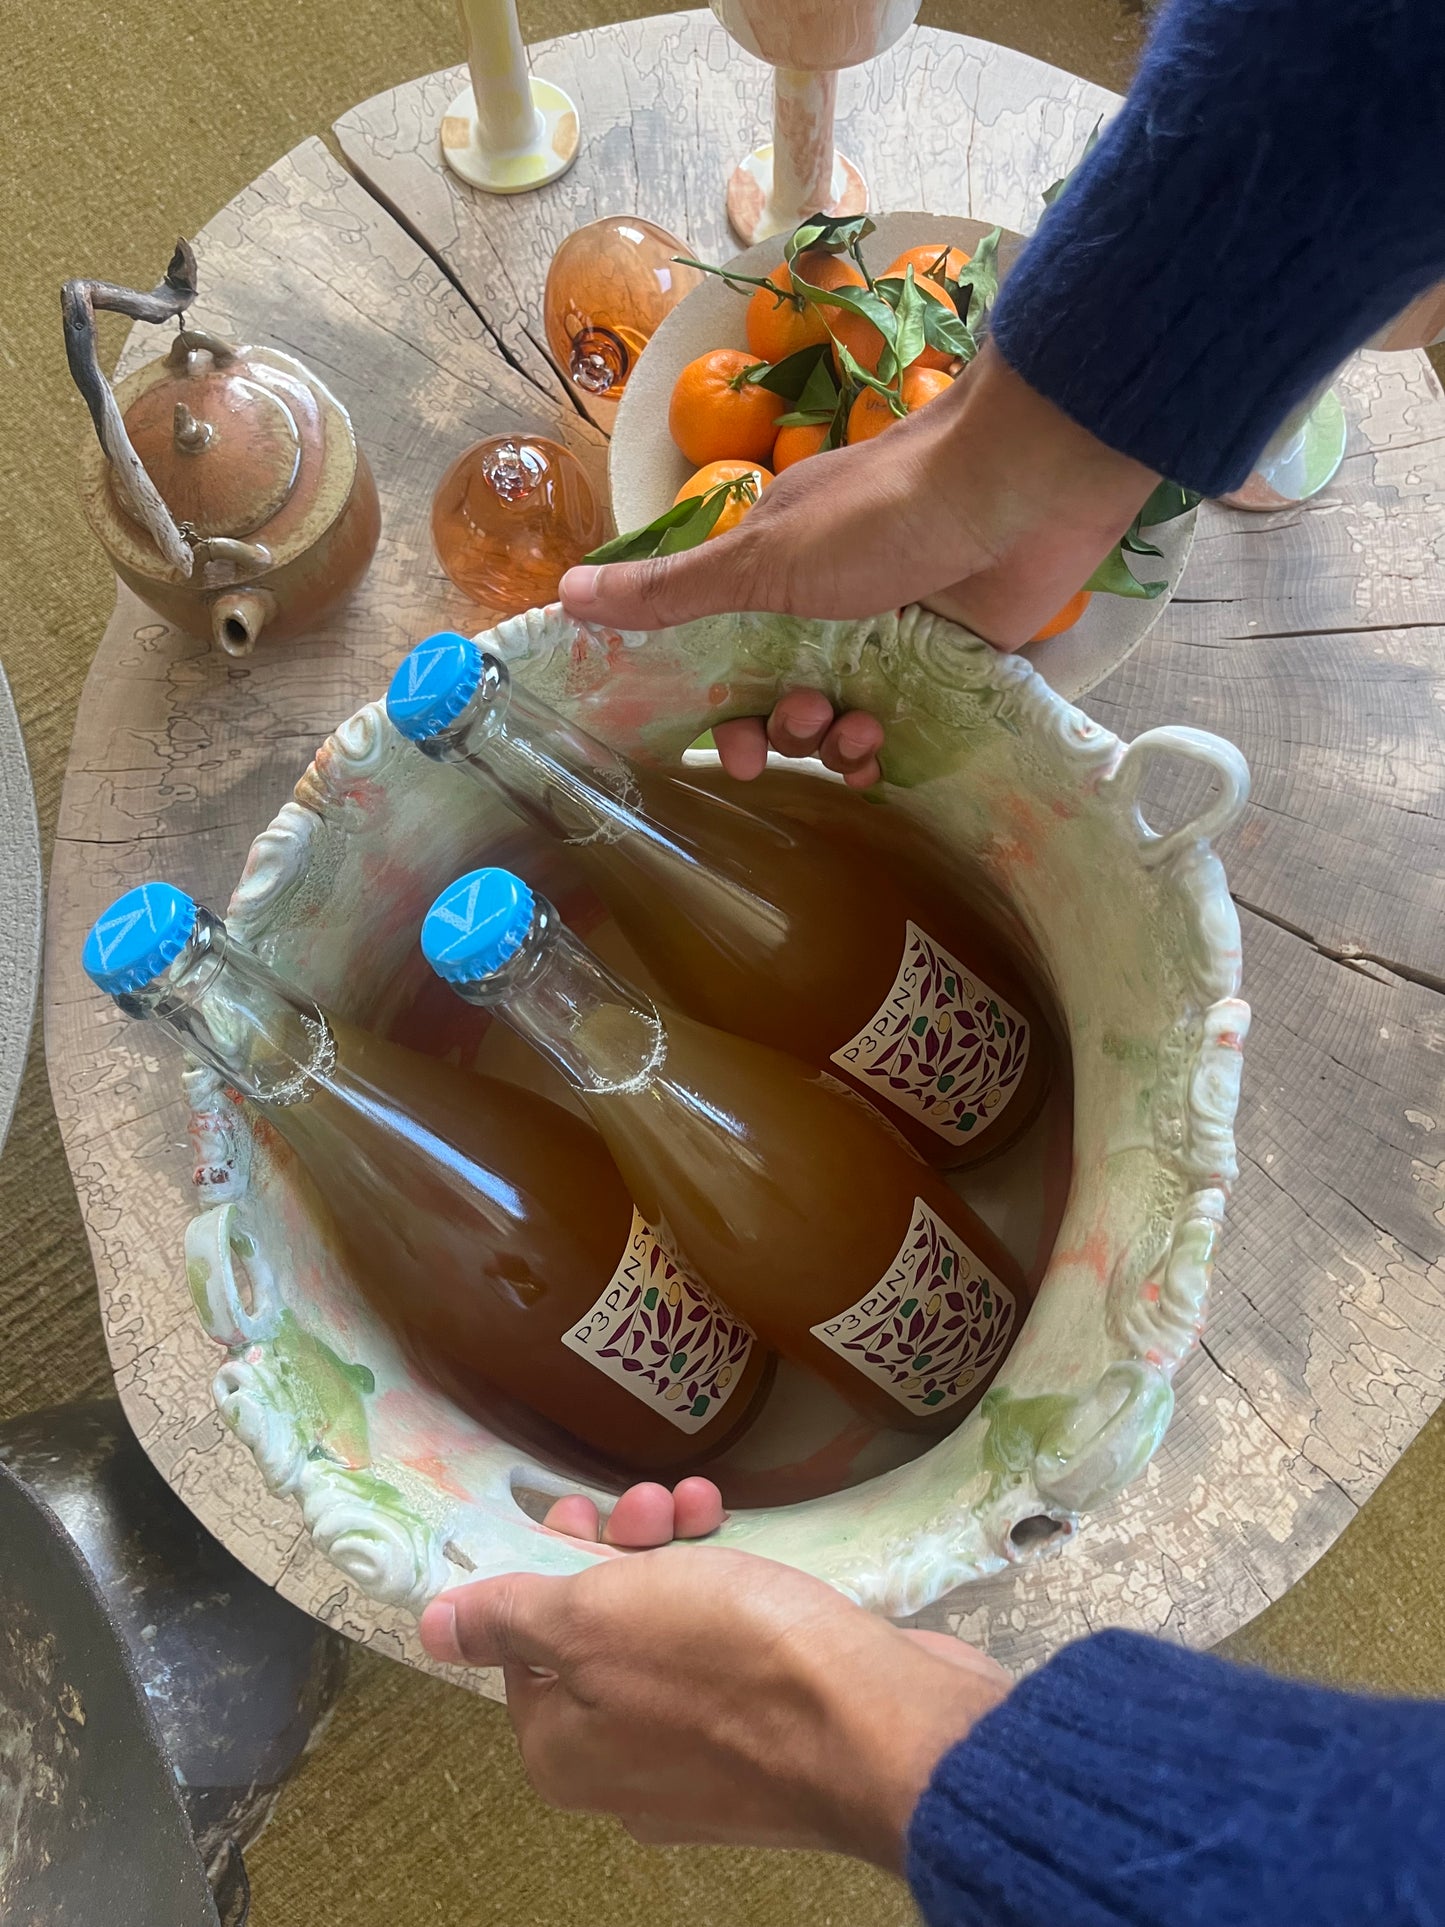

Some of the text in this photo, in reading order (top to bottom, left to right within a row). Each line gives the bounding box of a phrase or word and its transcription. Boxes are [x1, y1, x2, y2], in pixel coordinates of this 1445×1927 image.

[843, 966, 917, 1064] P3PINS
[574, 1234, 647, 1344] P3PINS
[823, 1248, 916, 1337] P3PINS
